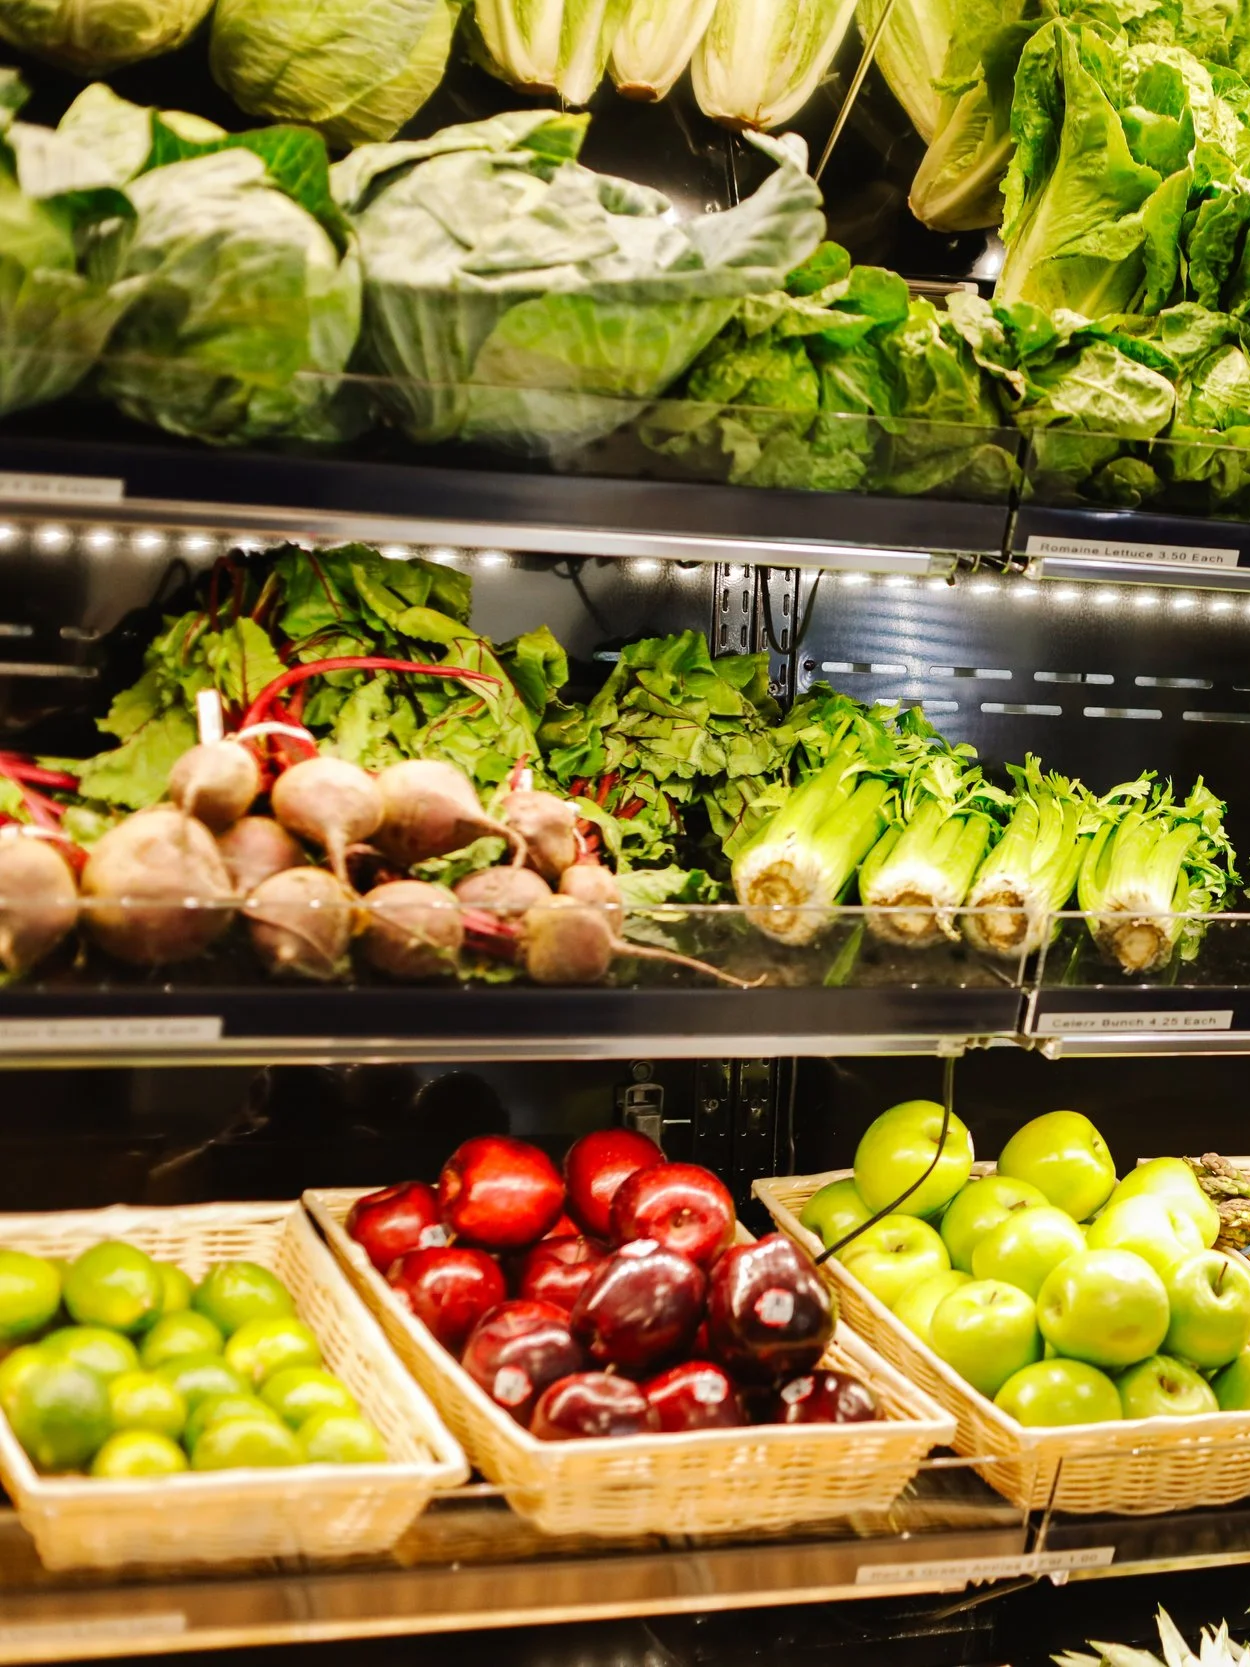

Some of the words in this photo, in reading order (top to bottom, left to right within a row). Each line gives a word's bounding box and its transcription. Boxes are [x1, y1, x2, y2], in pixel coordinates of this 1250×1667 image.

[1039, 542, 1100, 556] Romaine
[1104, 547, 1154, 559] Lettuce
[1158, 550, 1187, 561] 3.50
[1191, 553, 1224, 564] Each
[1102, 1018, 1144, 1028] Bunch
[1149, 1017, 1179, 1027] 4.25
[1184, 1016, 1217, 1026] Each
